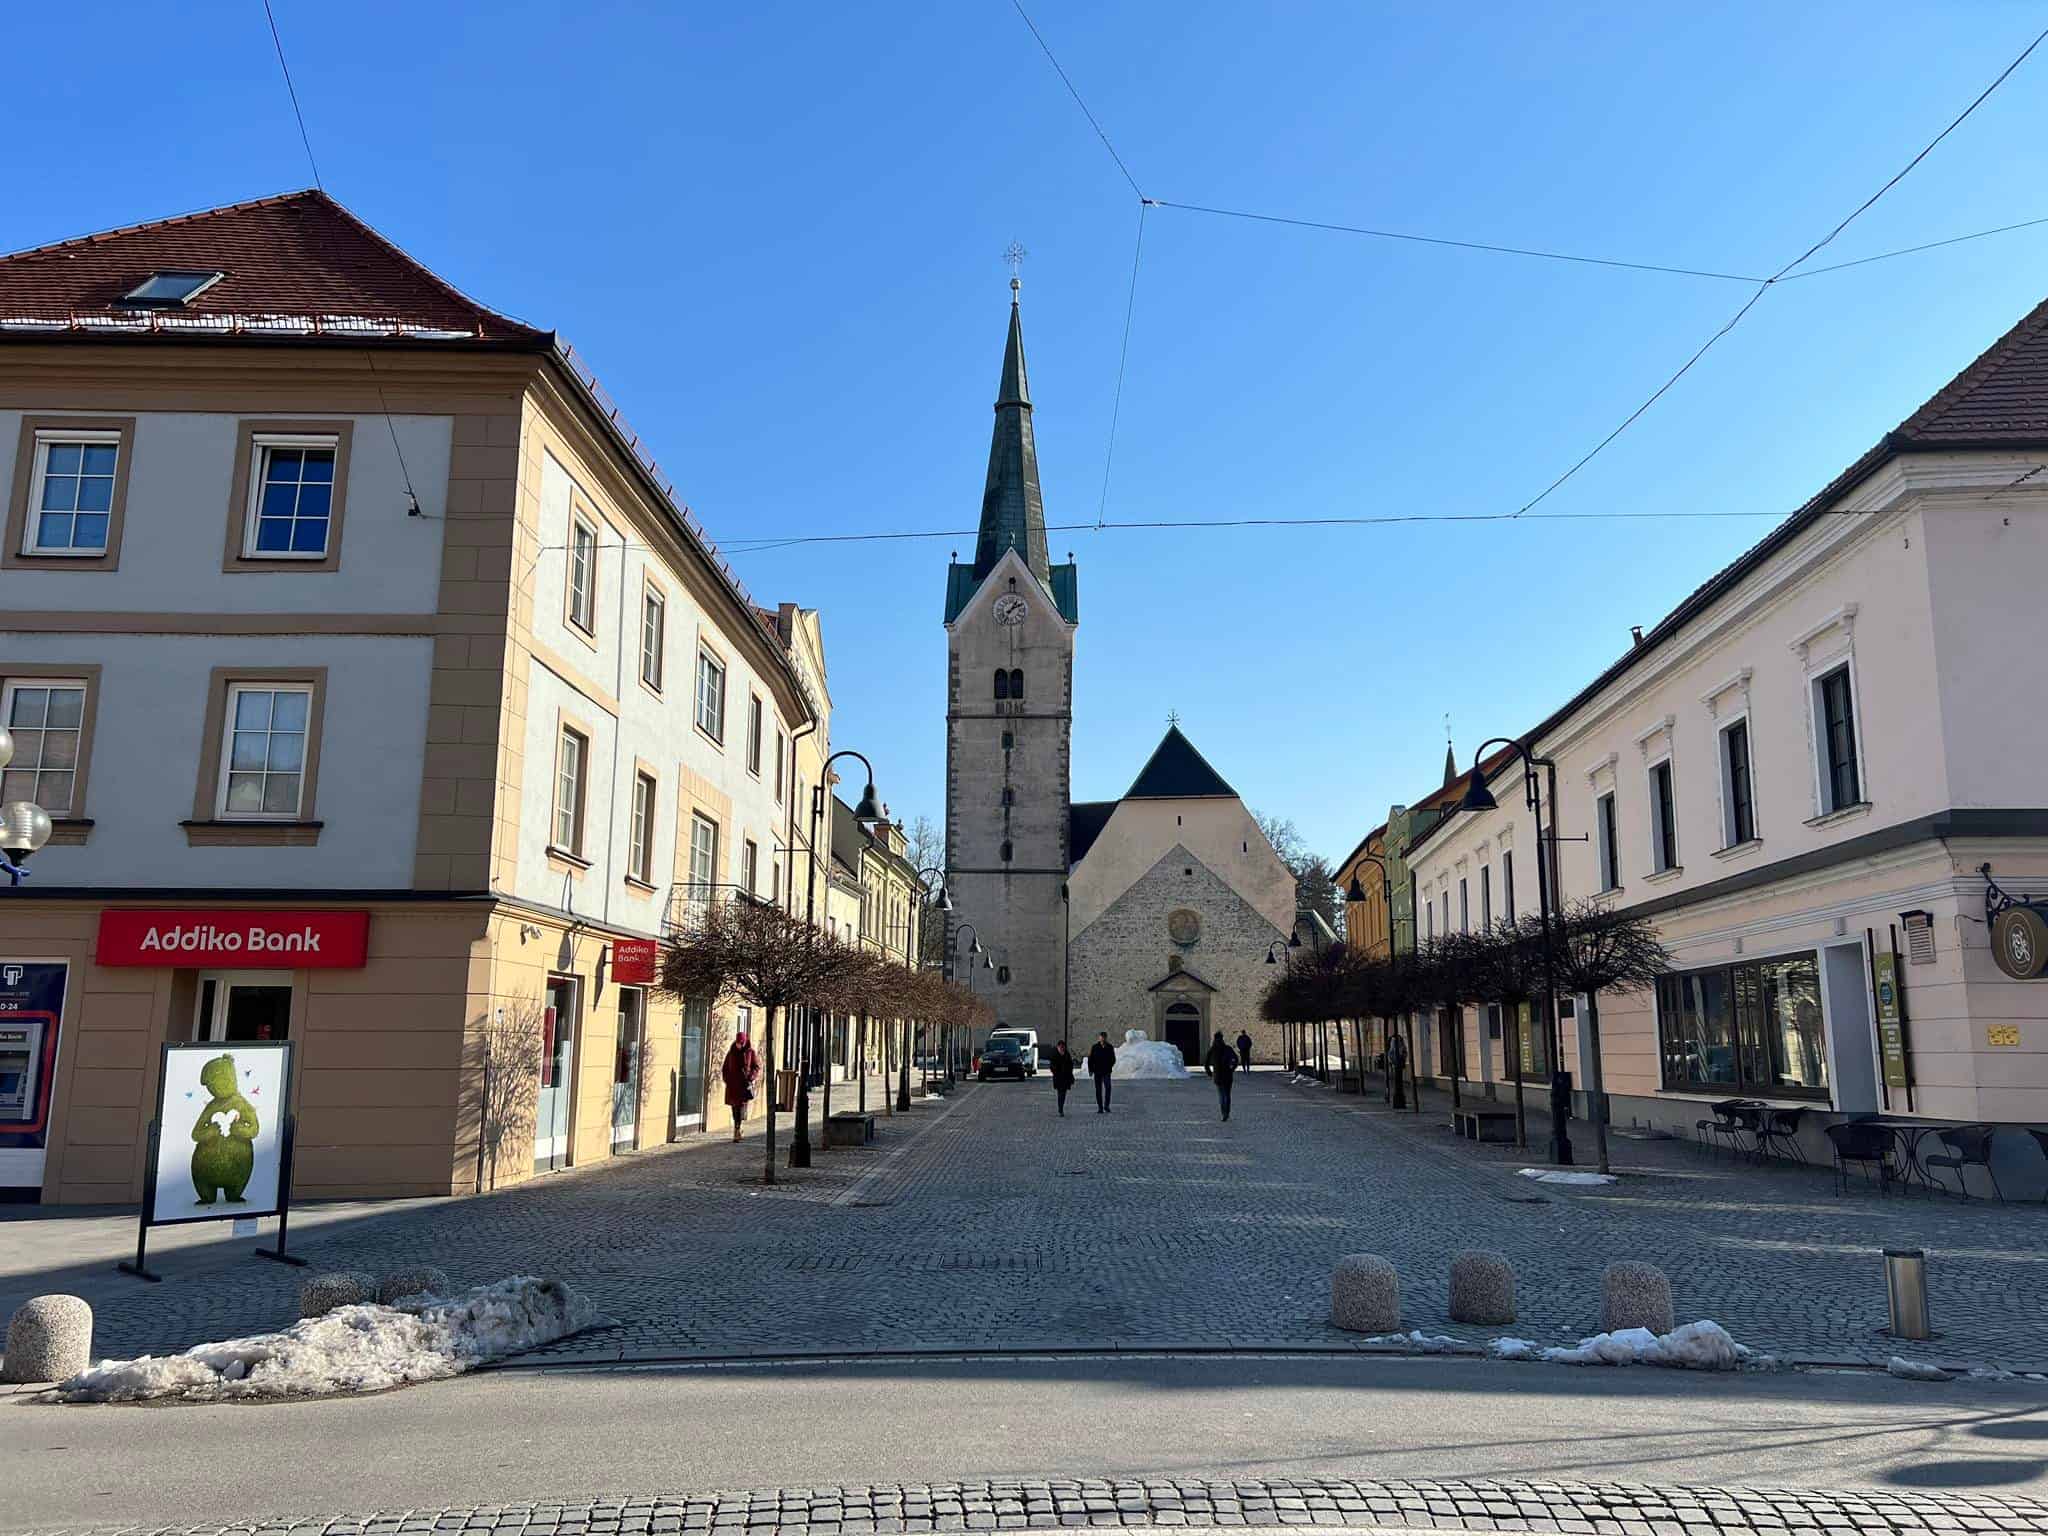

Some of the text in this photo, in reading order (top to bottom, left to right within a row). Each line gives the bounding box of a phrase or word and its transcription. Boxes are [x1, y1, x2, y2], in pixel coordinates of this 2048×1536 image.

[140, 925, 321, 952] Addiko Bank
[619, 945, 649, 953] Addiko
[618, 954, 640, 962] Bank
